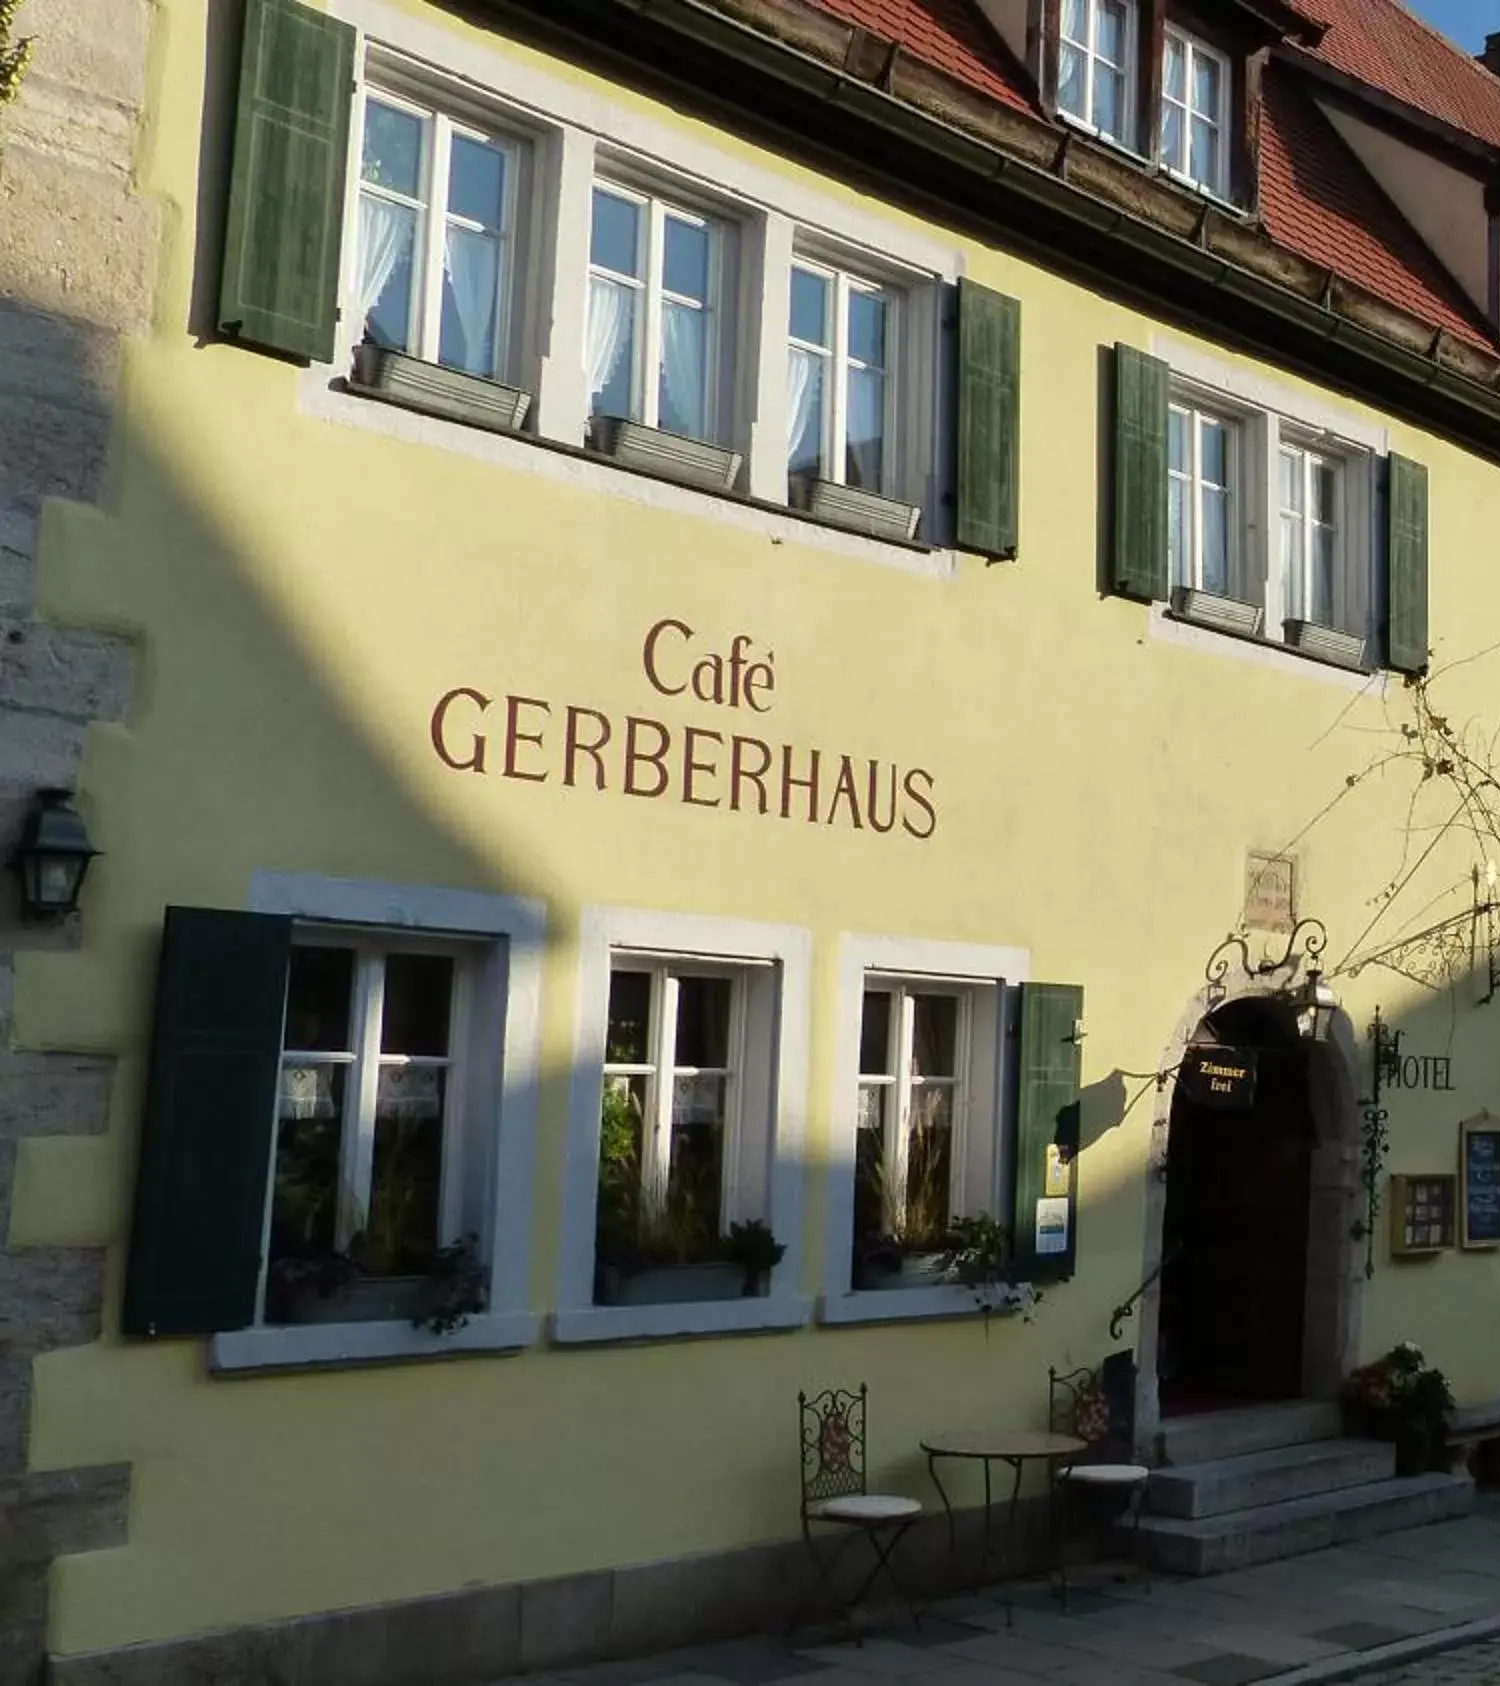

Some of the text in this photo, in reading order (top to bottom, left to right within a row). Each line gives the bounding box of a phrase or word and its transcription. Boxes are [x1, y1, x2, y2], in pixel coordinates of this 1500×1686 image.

[643, 619, 775, 712] Café
[430, 687, 936, 838] GERBERHAUS
[1387, 1055, 1456, 1091] HOTEL
